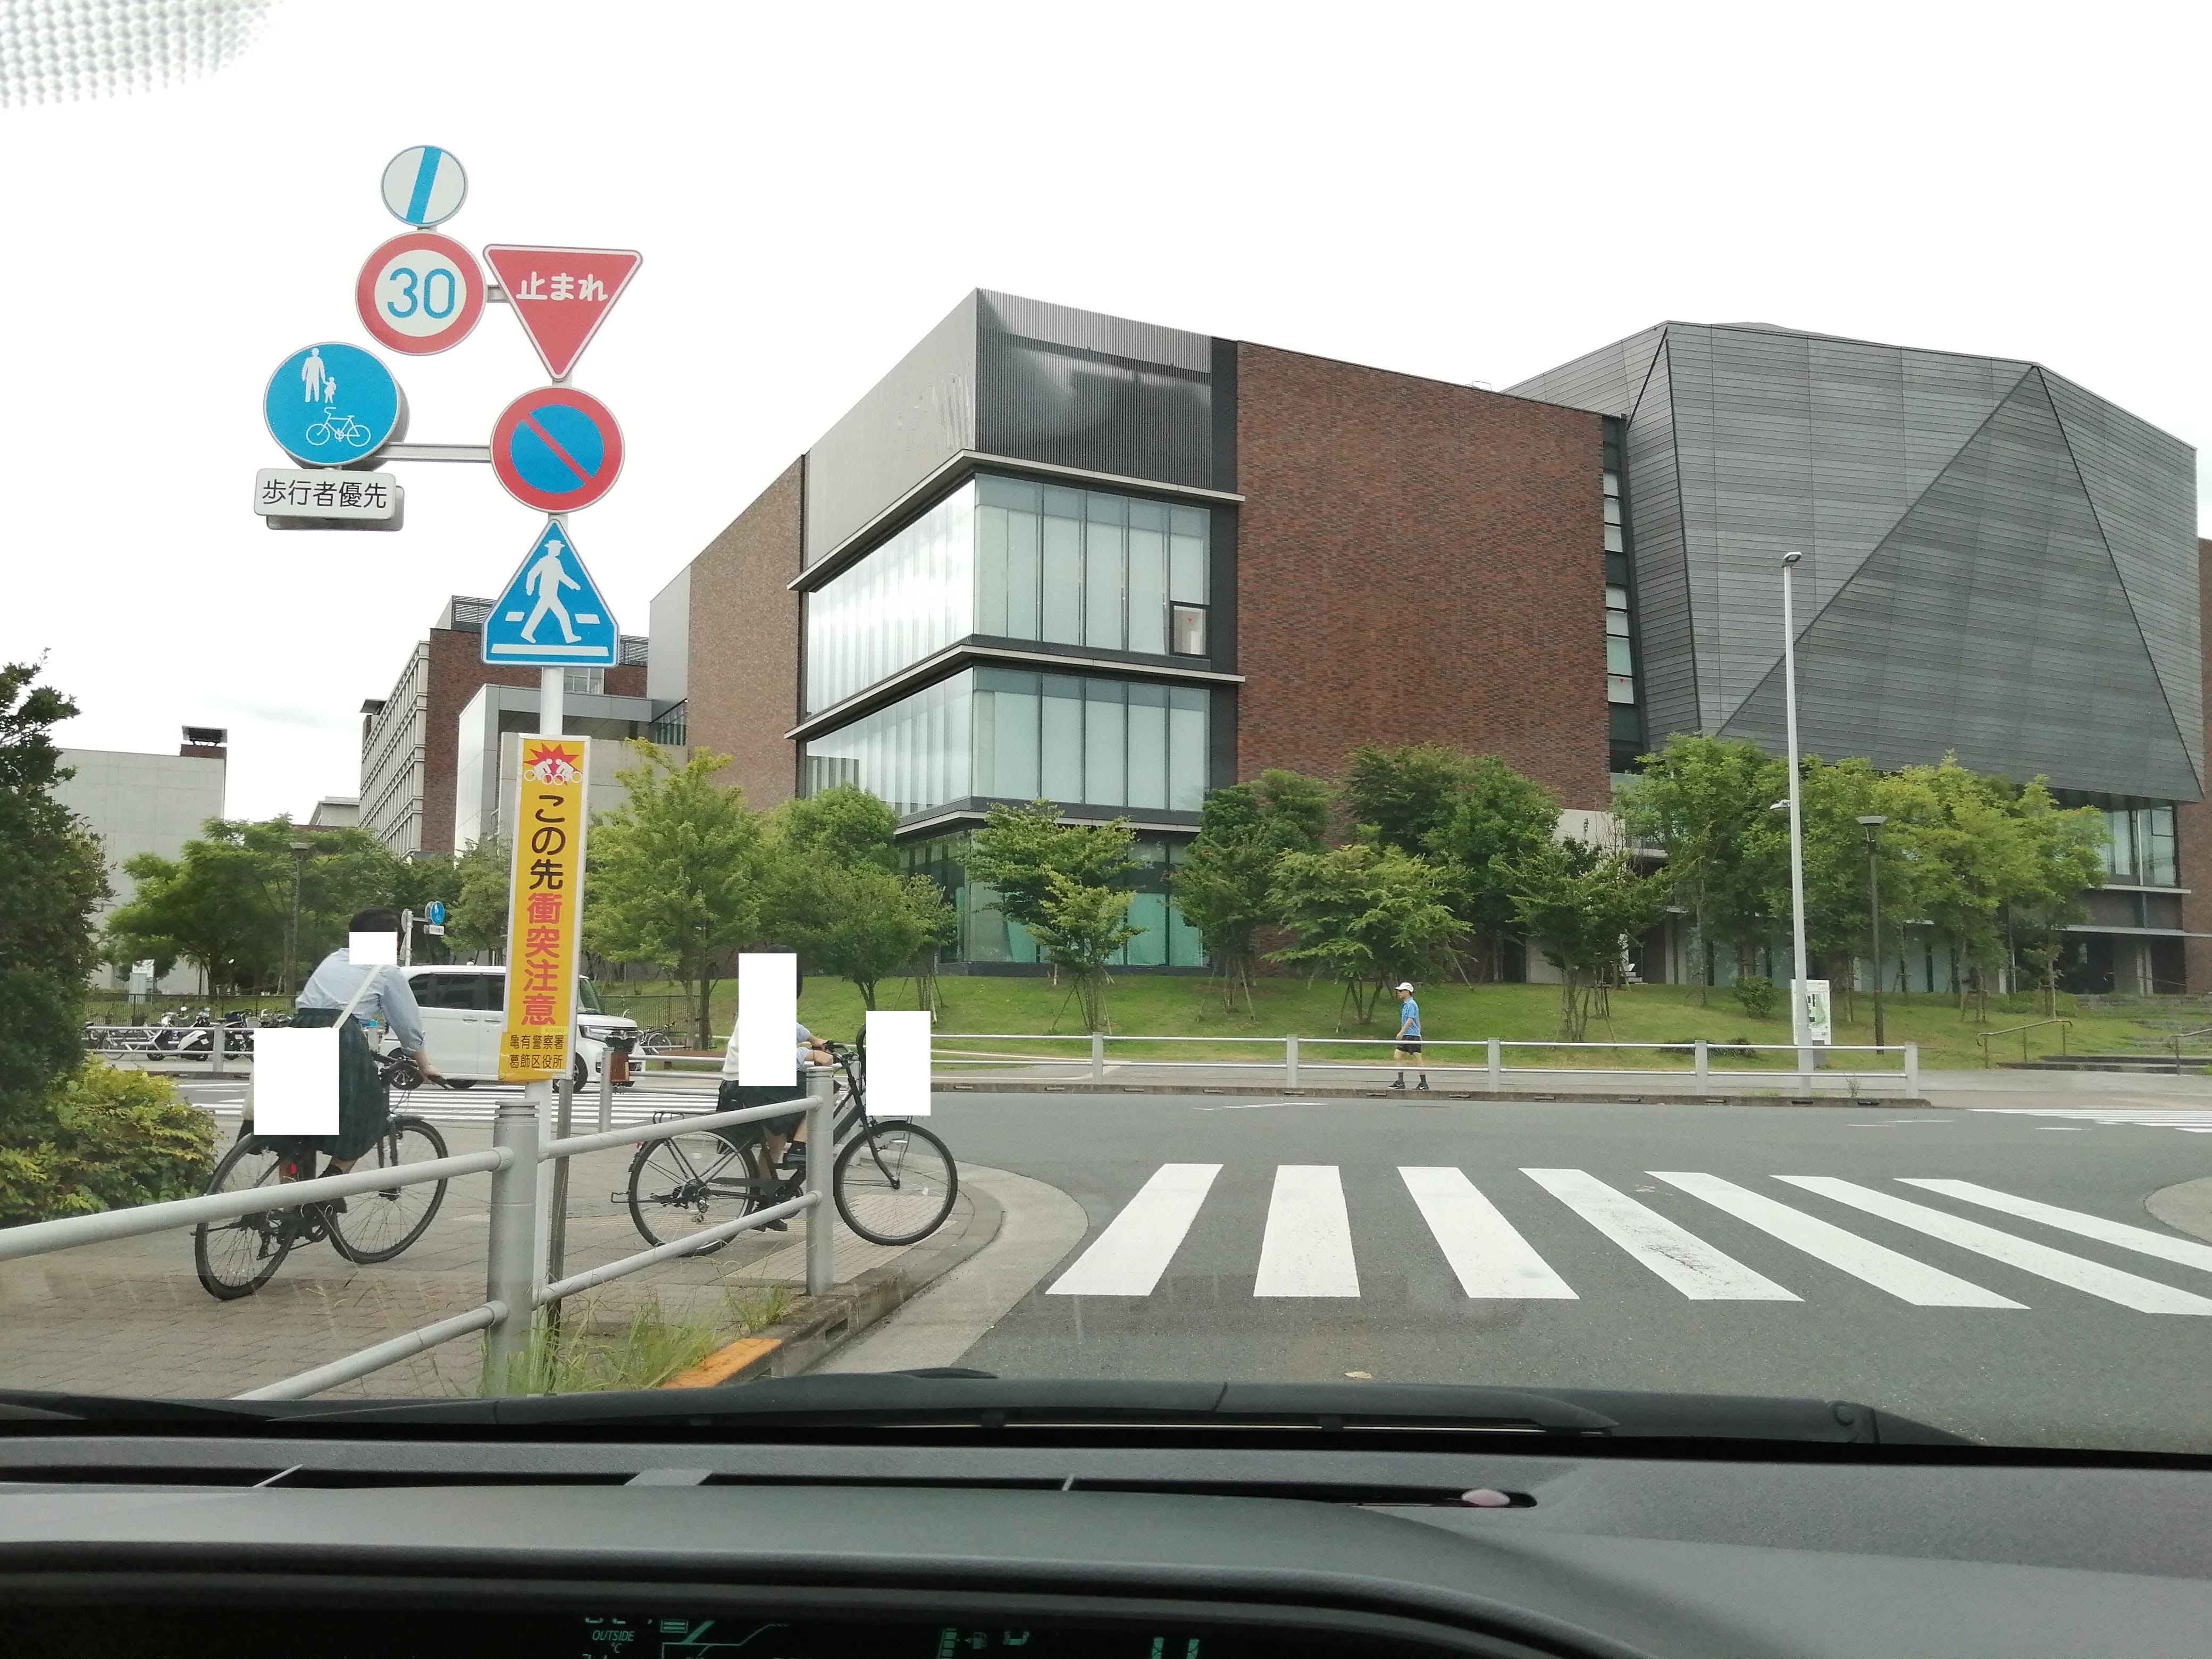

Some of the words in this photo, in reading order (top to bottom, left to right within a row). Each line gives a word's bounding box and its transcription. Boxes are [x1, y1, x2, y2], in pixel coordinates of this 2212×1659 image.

[388, 267, 456, 319] 30
[515, 272, 609, 302] 止まれ
[262, 479, 388, 509] 歩行者優先
[521, 794, 566, 1026] この先衝突注意
[510, 1034, 564, 1050] 亀有警察署
[510, 1054, 563, 1069] 葛飾区役所
[591, 1630, 635, 1642] OUTSIDE
